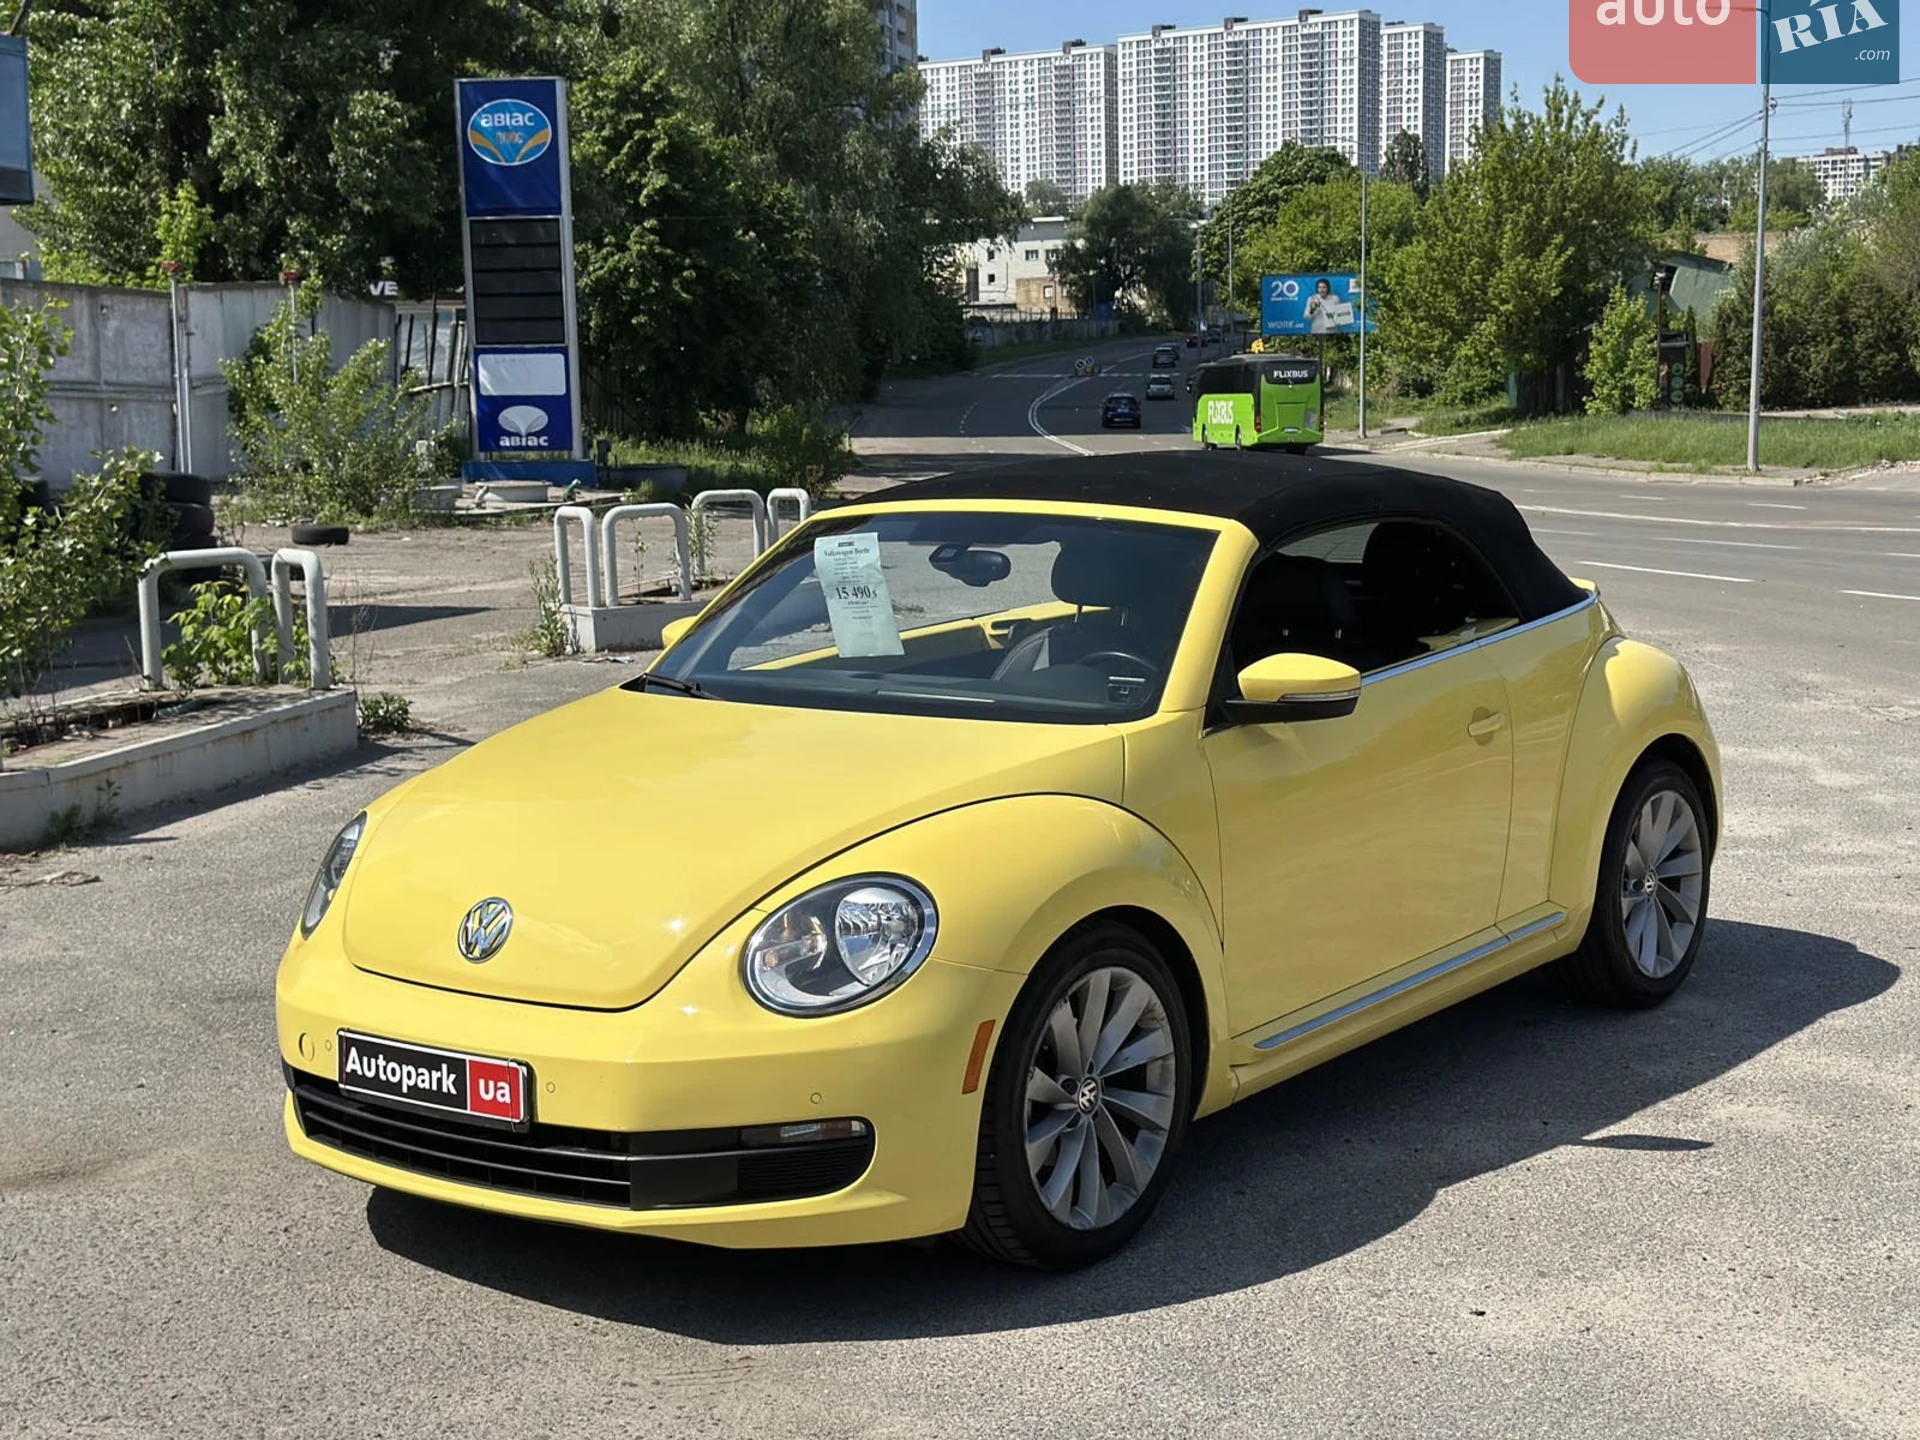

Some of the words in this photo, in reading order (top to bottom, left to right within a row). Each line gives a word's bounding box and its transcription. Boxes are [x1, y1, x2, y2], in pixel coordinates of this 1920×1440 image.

[1271, 280, 1299, 297] 20
[836, 587, 849, 600] 15
[851, 585, 871, 599] 490
[345, 1046, 458, 1095] Autopark
[478, 1077, 511, 1104] ua
